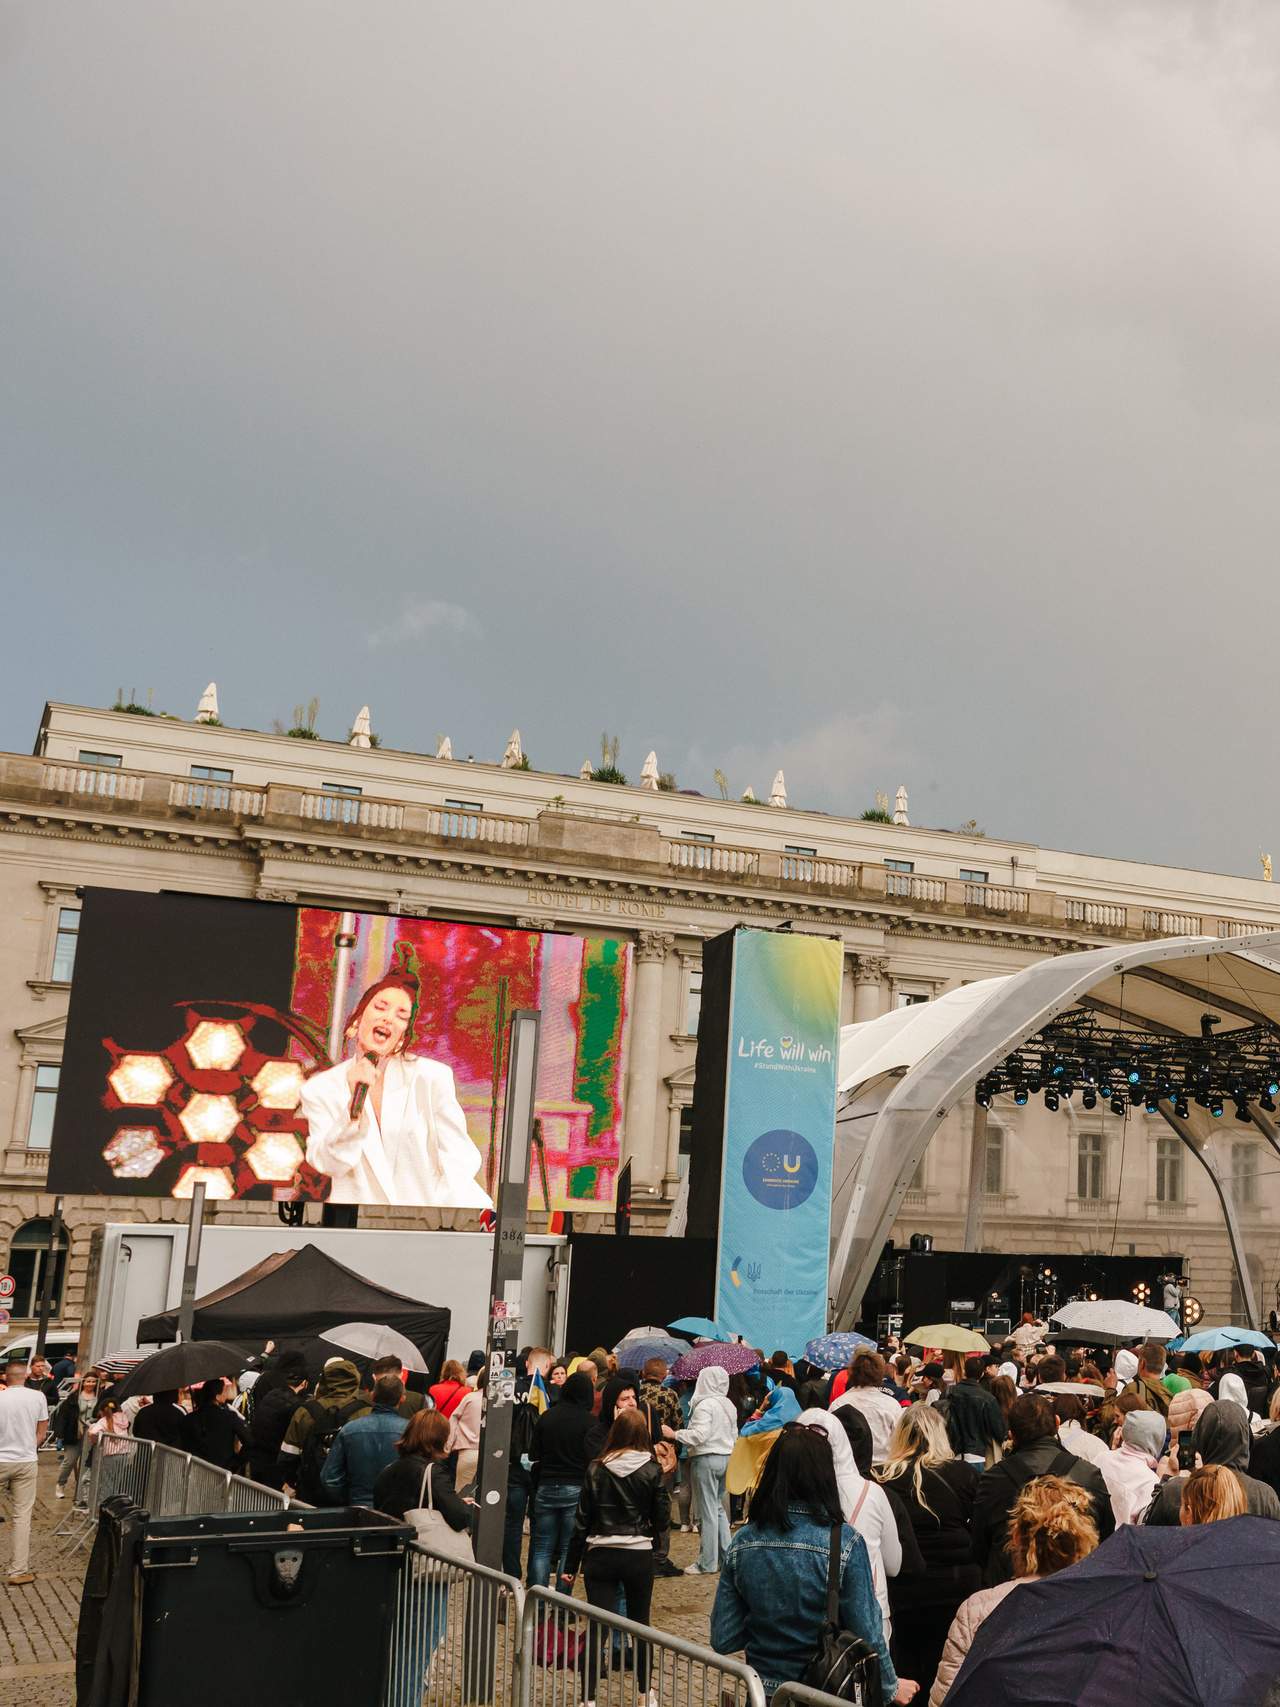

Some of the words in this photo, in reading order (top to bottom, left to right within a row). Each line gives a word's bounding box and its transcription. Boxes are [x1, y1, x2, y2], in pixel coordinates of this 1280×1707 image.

[527, 890, 583, 909] HOTEL
[590, 898, 611, 912] DE
[618, 901, 666, 918] ROME
[738, 1036, 774, 1058] Life
[780, 1042, 805, 1061] will
[808, 1044, 831, 1063] win
[502, 1231, 523, 1240] 384
